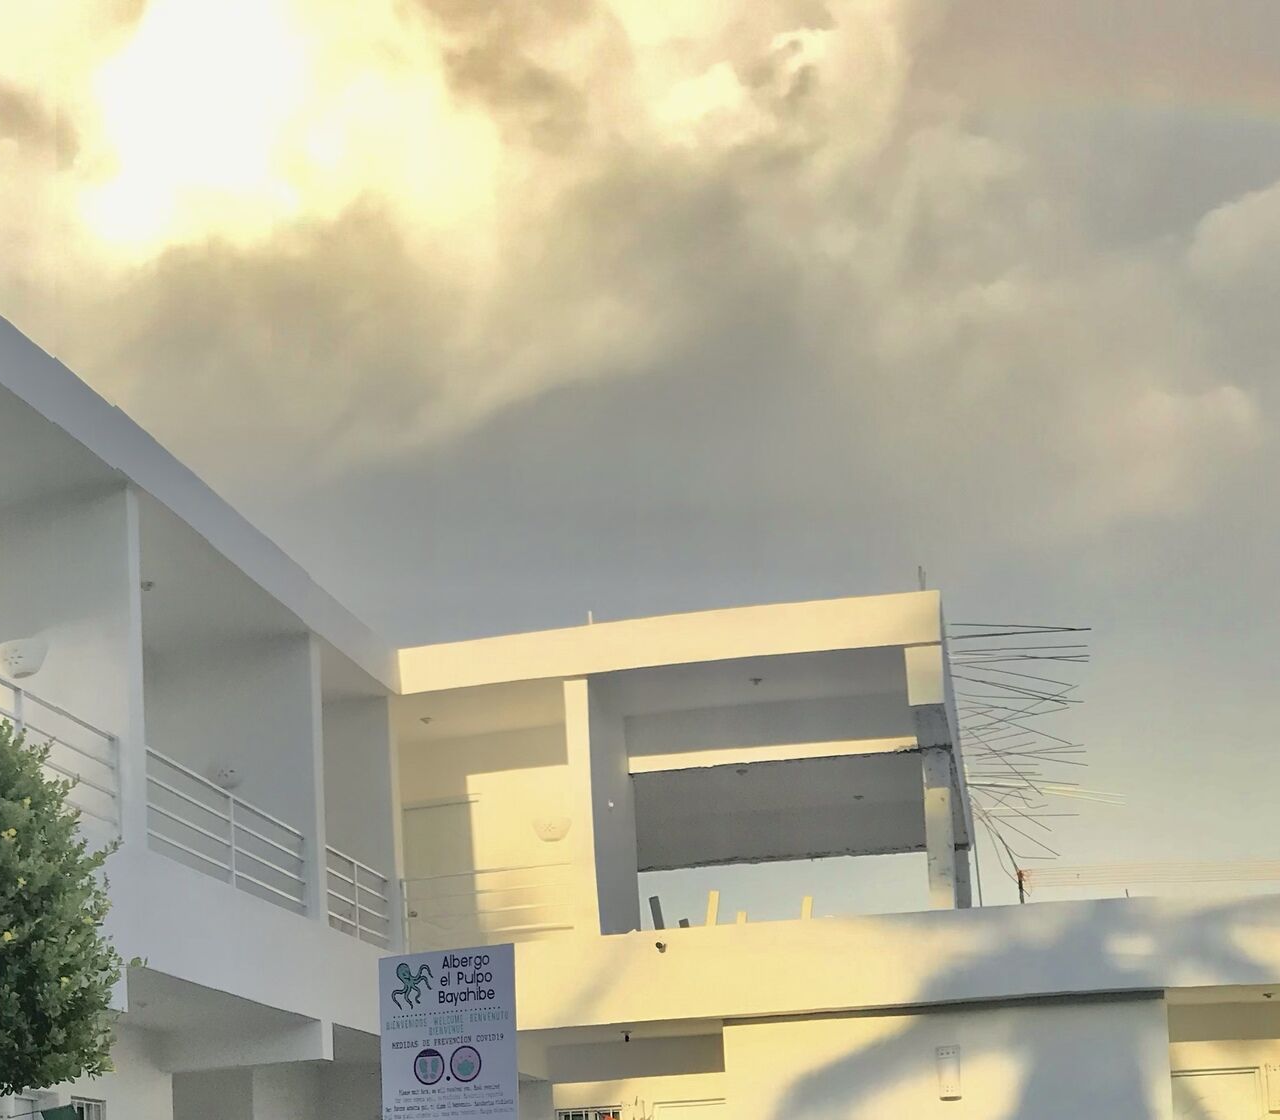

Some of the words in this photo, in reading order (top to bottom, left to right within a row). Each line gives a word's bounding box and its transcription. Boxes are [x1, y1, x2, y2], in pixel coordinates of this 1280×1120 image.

[441, 954, 490, 970] Albergo
[439, 971, 451, 987] el
[457, 969, 493, 987] Pulpo
[438, 986, 496, 1006] Bayahibe
[433, 1014, 464, 1026] WELCOME
[469, 1010, 509, 1023] BENVENUTO
[391, 1040, 419, 1050] MEDIDAS
[422, 1039, 430, 1047] DE
[475, 1033, 505, 1043] COVID19
